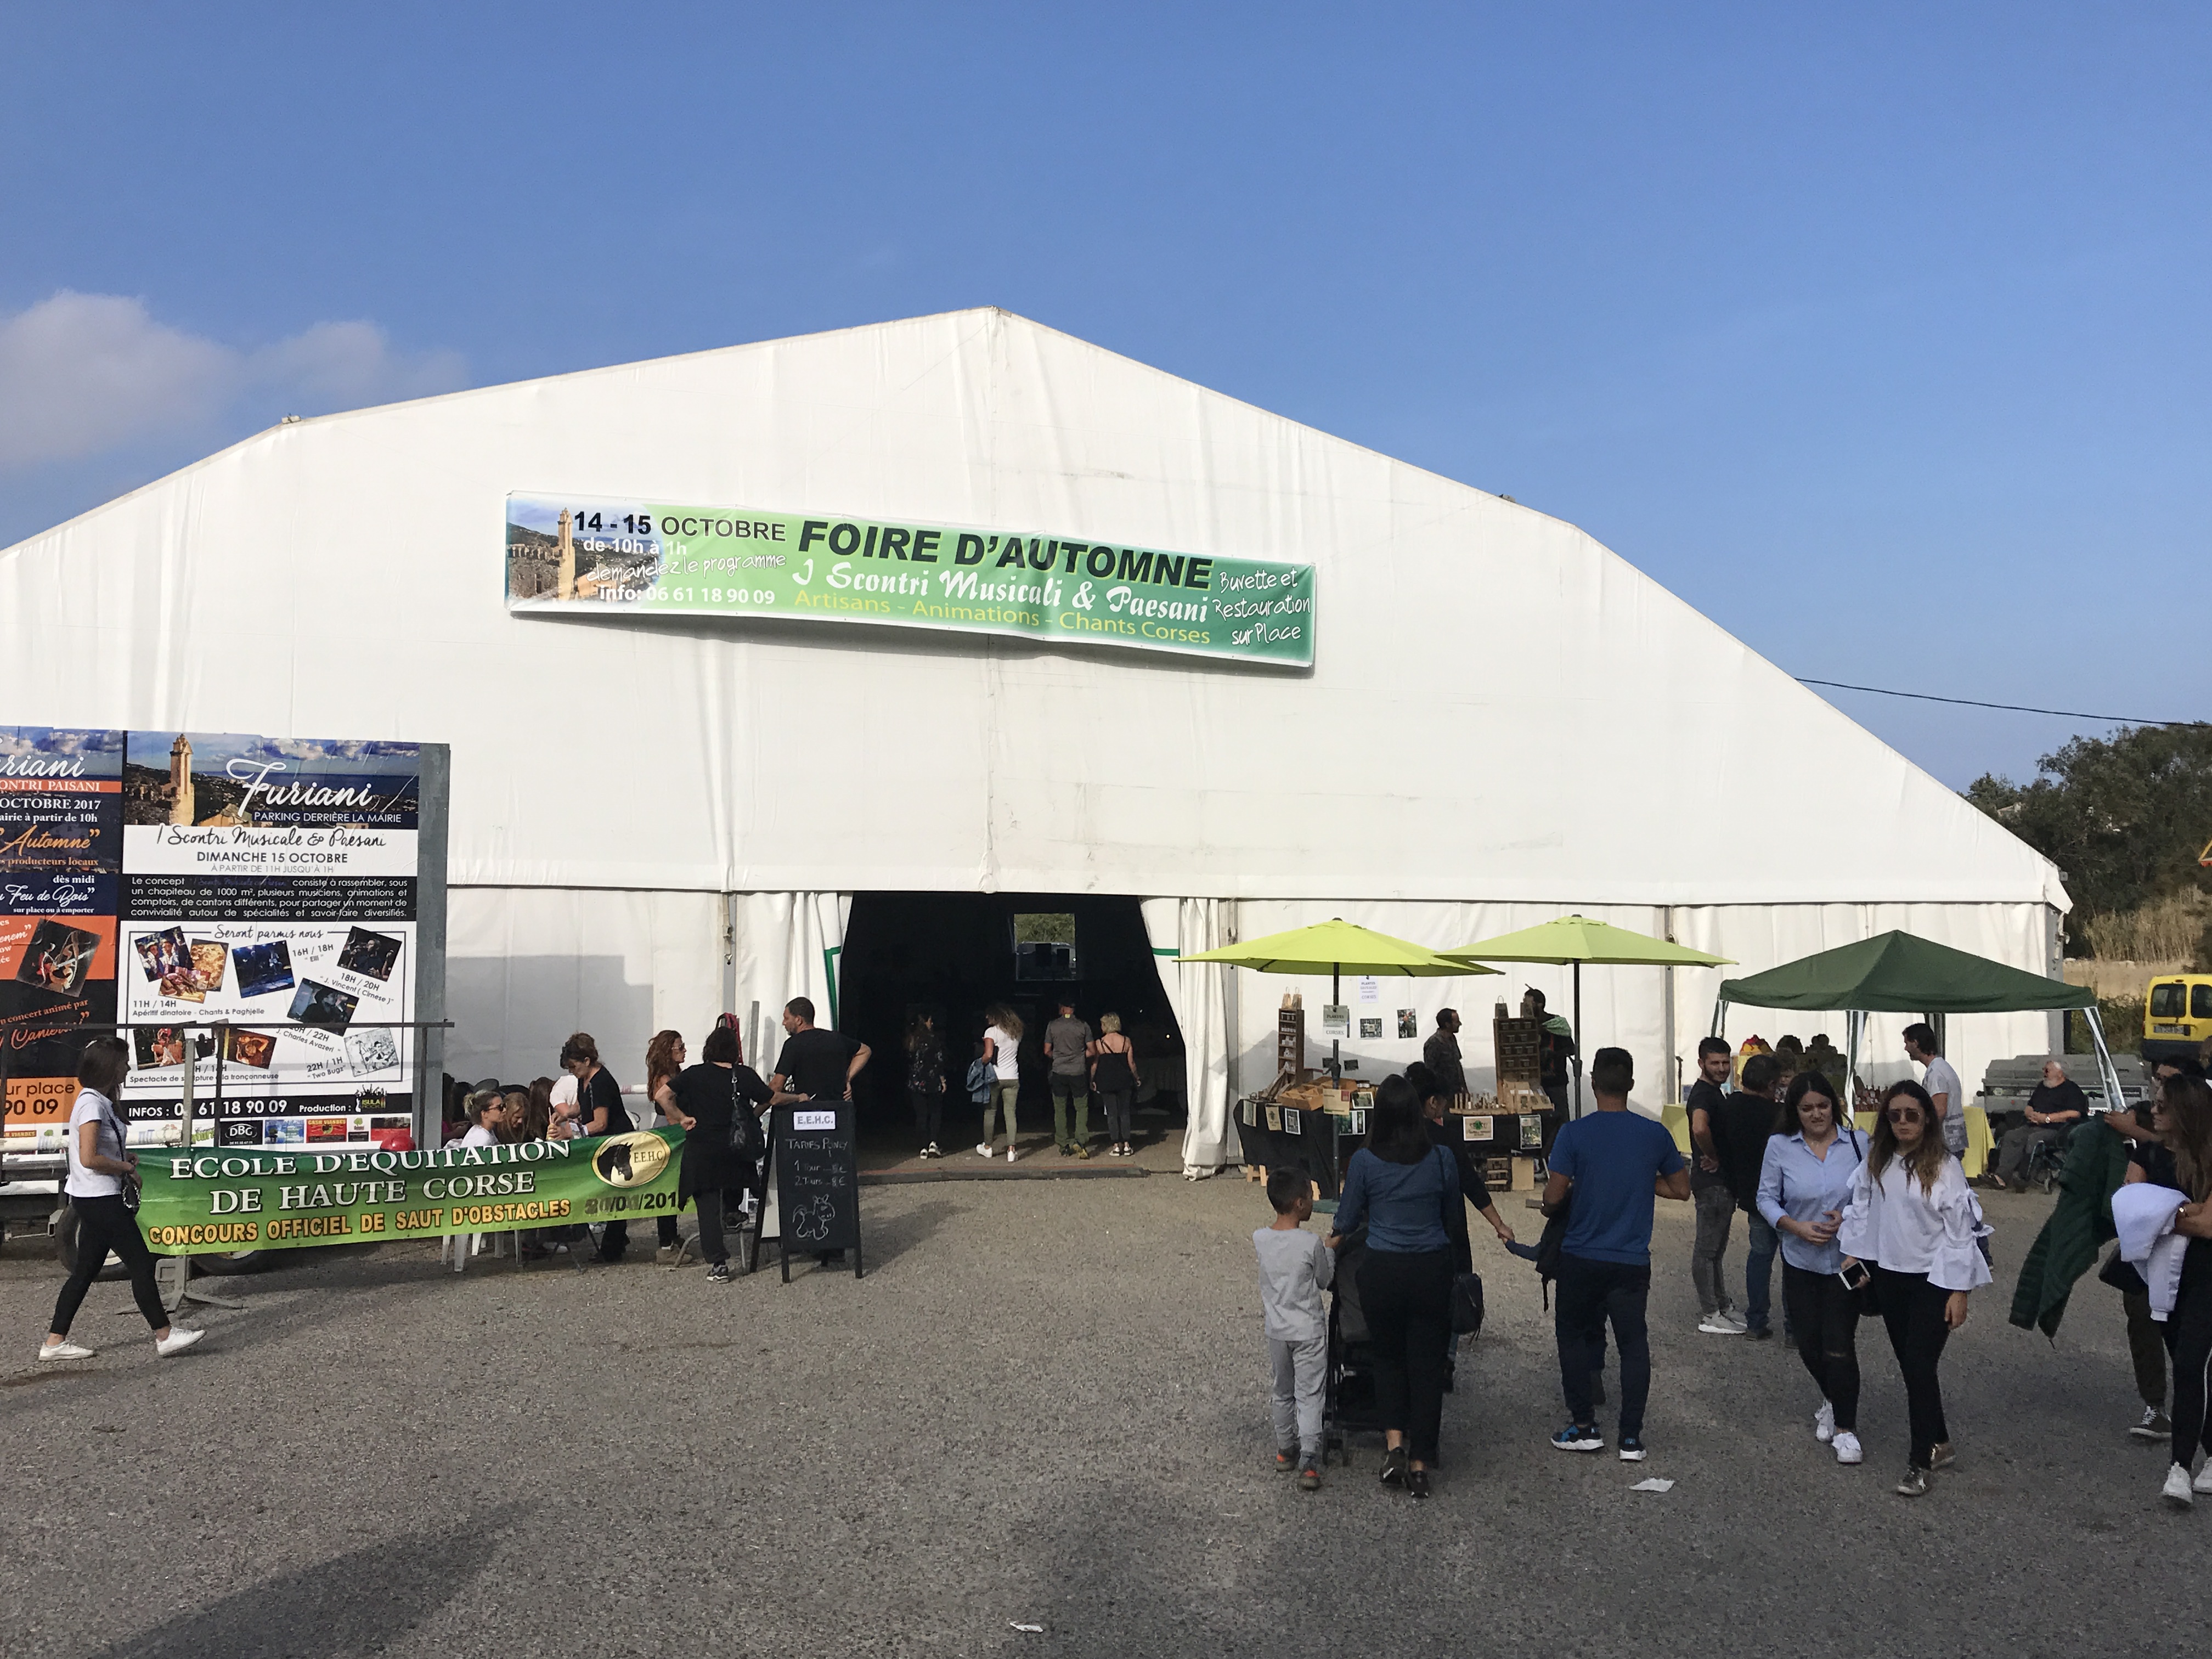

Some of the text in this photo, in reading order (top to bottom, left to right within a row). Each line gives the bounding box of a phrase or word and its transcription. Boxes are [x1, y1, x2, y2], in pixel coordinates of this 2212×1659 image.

[574, 511, 786, 541] 14 15 OCTOBRE
[584, 538, 687, 555] de 10h à 1h
[798, 520, 941, 563] FOIRE
[586, 554, 786, 583] demandez le programme
[1219, 567, 1298, 594] Buvette et
[600, 585, 775, 604] info: 06 61 18 90 09
[826, 562, 1208, 623] Scontri Musicali & Paesani
[1212, 594, 1311, 621] Restauration
[794, 589, 1210, 644] Artisans Animations Chants Corses
[1231, 622, 1301, 646] sur Place
[48, 781, 100, 792] PAISANI
[226, 759, 373, 817] Furiani
[0, 798, 101, 810] OCTOBRE 2017
[25, 812, 31, 821] à
[33, 814, 63, 824] partir
[64, 813, 77, 822] de
[80, 813, 98, 822] 10h
[254, 811, 300, 822] PARKING
[304, 811, 349, 822] DERRIÈRE
[368, 814, 401, 823] MAIRIE
[167, 825, 386, 848] Scontri Musicale & Paesani
[8, 856, 99, 867] producteurs locaux
[197, 852, 348, 864] DIMANCHE 15 OCTOBRE
[220, 864, 248, 872] PARTIR
[324, 865, 334, 873] 1H
[53, 875, 95, 883] dès midi
[132, 877, 143, 885] Le
[145, 878, 185, 887] concept
[330, 878, 336, 887] à
[338, 879, 387, 888] rassembler,
[5, 884, 50, 905] Feu de
[148, 888, 195, 896] chapiteau
[200, 888, 212, 896] de
[217, 888, 237, 896] 1000
[258, 889, 295, 898] plusieurs
[298, 889, 342, 898] musiciens,
[26, 906, 44, 915] place
[131, 898, 179, 907] comptoirs,
[234, 898, 276, 907] différents,
[302, 899, 341, 909] partager
[356, 899, 393, 907] moment
[131, 908, 182, 916] convivialité
[224, 909, 237, 917] de
[243, 908, 290, 918] spécialités
[311, 909, 358, 917] savoir-faire
[215, 924, 324, 942] Seront parmis nous
[292, 944, 334, 957] 16H 18H
[332, 979, 357, 992] Vincent
[341, 973, 380, 991] 18H 20H
[8, 999, 88, 1023] concert animé par
[283, 1030, 308, 1043] Charles
[313, 1031, 330, 1042] 22H
[307, 1056, 343, 1073] 22H 1H
[130, 1075, 167, 1084] Spectacle
[231, 1073, 279, 1082] tronçonneuse
[312, 1071, 326, 1080] Two
[27, 1082, 75, 1097] place
[4, 1099, 59, 1115] 90 09
[129, 1099, 287, 1117] INFOS 61 18 90 09
[300, 1104, 346, 1113] Production
[797, 1115, 834, 1125] E.E.H.C.
[230, 1125, 252, 1137] DBG
[785, 1138, 821, 1150] TARIFS
[170, 1139, 570, 1180] ECOLE D'EQUITATION
[210, 1171, 535, 1215] DE HAUTE CORSE
[149, 1199, 571, 1245] CONCOURS OFFICIEL DE SAUT D'OBSTACLES
